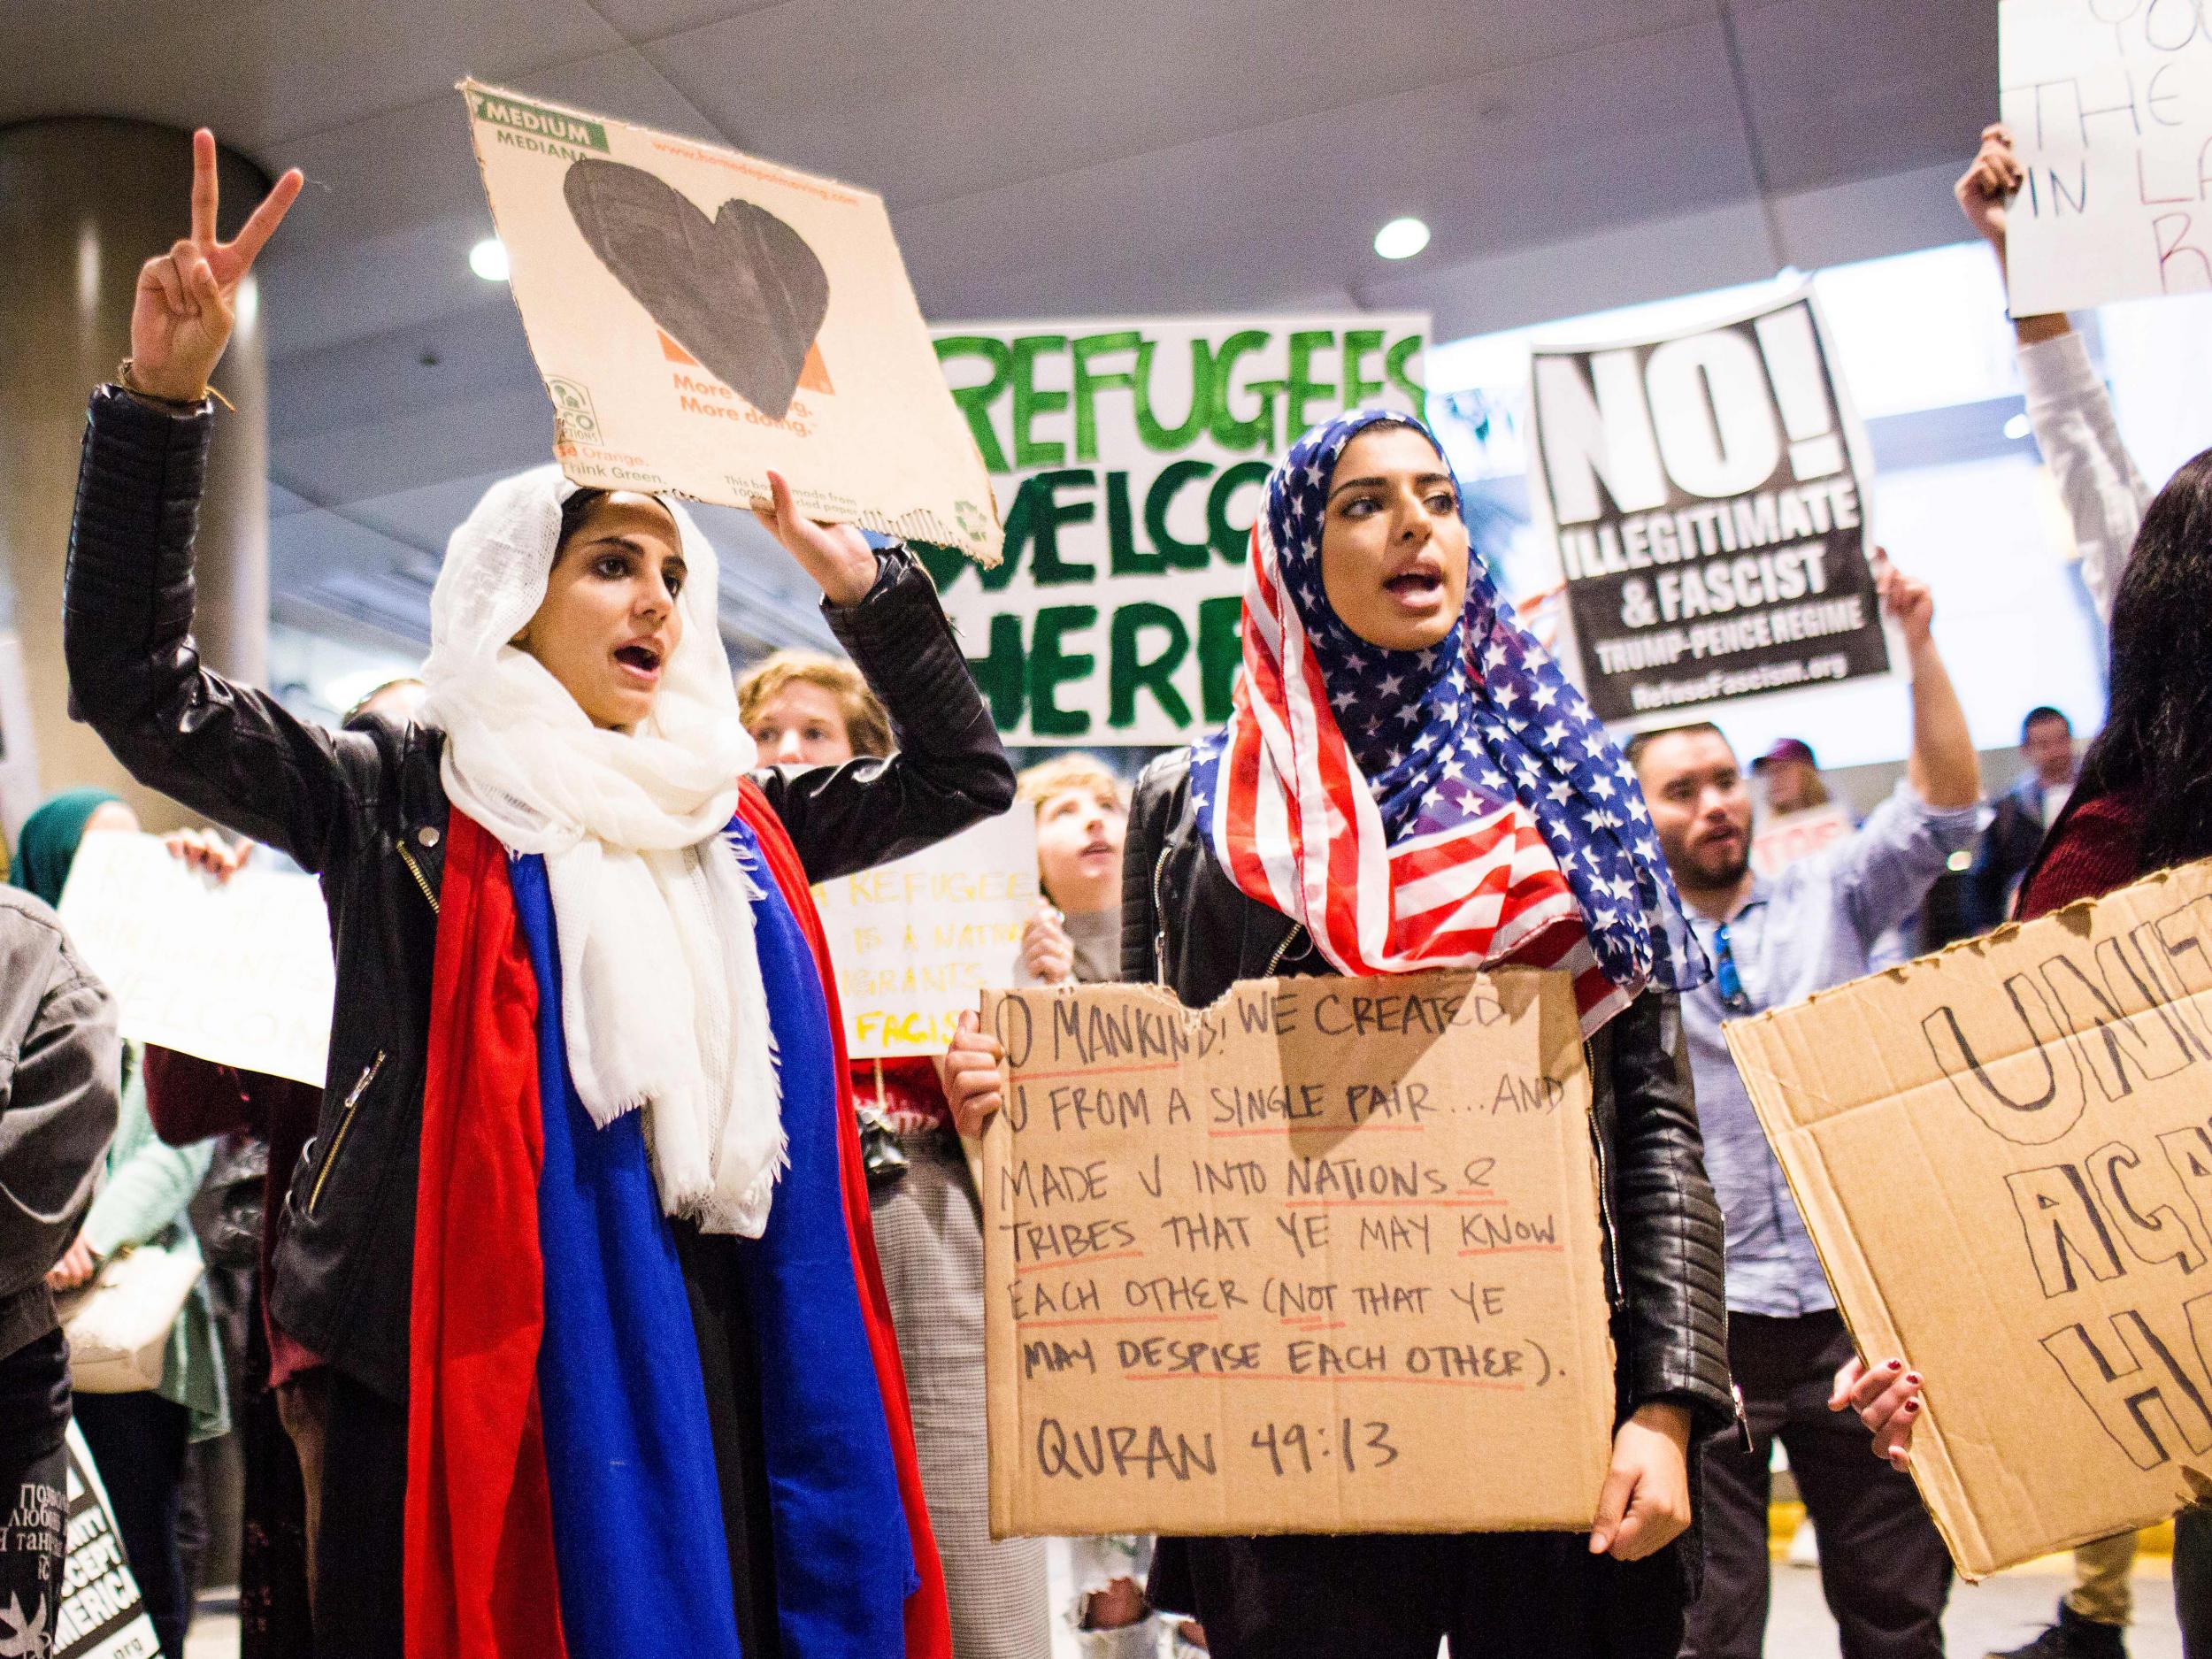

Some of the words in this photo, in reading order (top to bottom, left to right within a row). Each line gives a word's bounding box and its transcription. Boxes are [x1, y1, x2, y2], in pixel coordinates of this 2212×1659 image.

[2086, 0, 2212, 57] YO
[485, 102, 591, 147] MEDIUM
[2001, 63, 2185, 150] THE
[2027, 159, 2088, 219] IN
[672, 373, 733, 400] More
[679, 395, 740, 422] More
[1535, 303, 1843, 526] NO!
[561, 411, 595, 432] CO
[1560, 479, 1860, 581] ILLEGITIMATE
[1621, 575, 1660, 630] &
[1658, 541, 1828, 624] FASCIST
[1594, 611, 1771, 675] TRUMP-PENCE
[1770, 595, 1865, 647] REGIME
[995, 994, 1033, 1069] O
[1238, 989, 1299, 1036] WE
[1314, 992, 1505, 1037] CREATED
[1048, 1085, 1150, 1133] FROM
[1167, 1087, 1193, 1126] A
[1210, 1084, 1325, 1127] SINGLE
[1000, 1159, 1109, 1212] MADE
[1192, 1159, 1267, 1196] INTO
[1286, 1156, 1449, 1202] NATIONS
[999, 1217, 1136, 1263] TRIBES
[1160, 1211, 1251, 1252] THAT
[1276, 1211, 1331, 1259] YE
[1359, 1214, 1432, 1256] MAY
[1460, 1212, 1556, 1249] KNOW
[1006, 1279, 1101, 1322] EACH
[1125, 1275, 1248, 1314] OTHER
[1262, 1276, 1339, 1318] (NOT
[1351, 1281, 1432, 1317] THAT
[1449, 1280, 1506, 1325] YE
[1022, 1338, 1097, 1380] MAY
[1116, 1336, 1262, 1374] DESPISE
[1286, 1340, 1387, 1377] EACH
[1036, 1417, 1218, 1482] QURAN
[1250, 1417, 1400, 1479] 49:13
